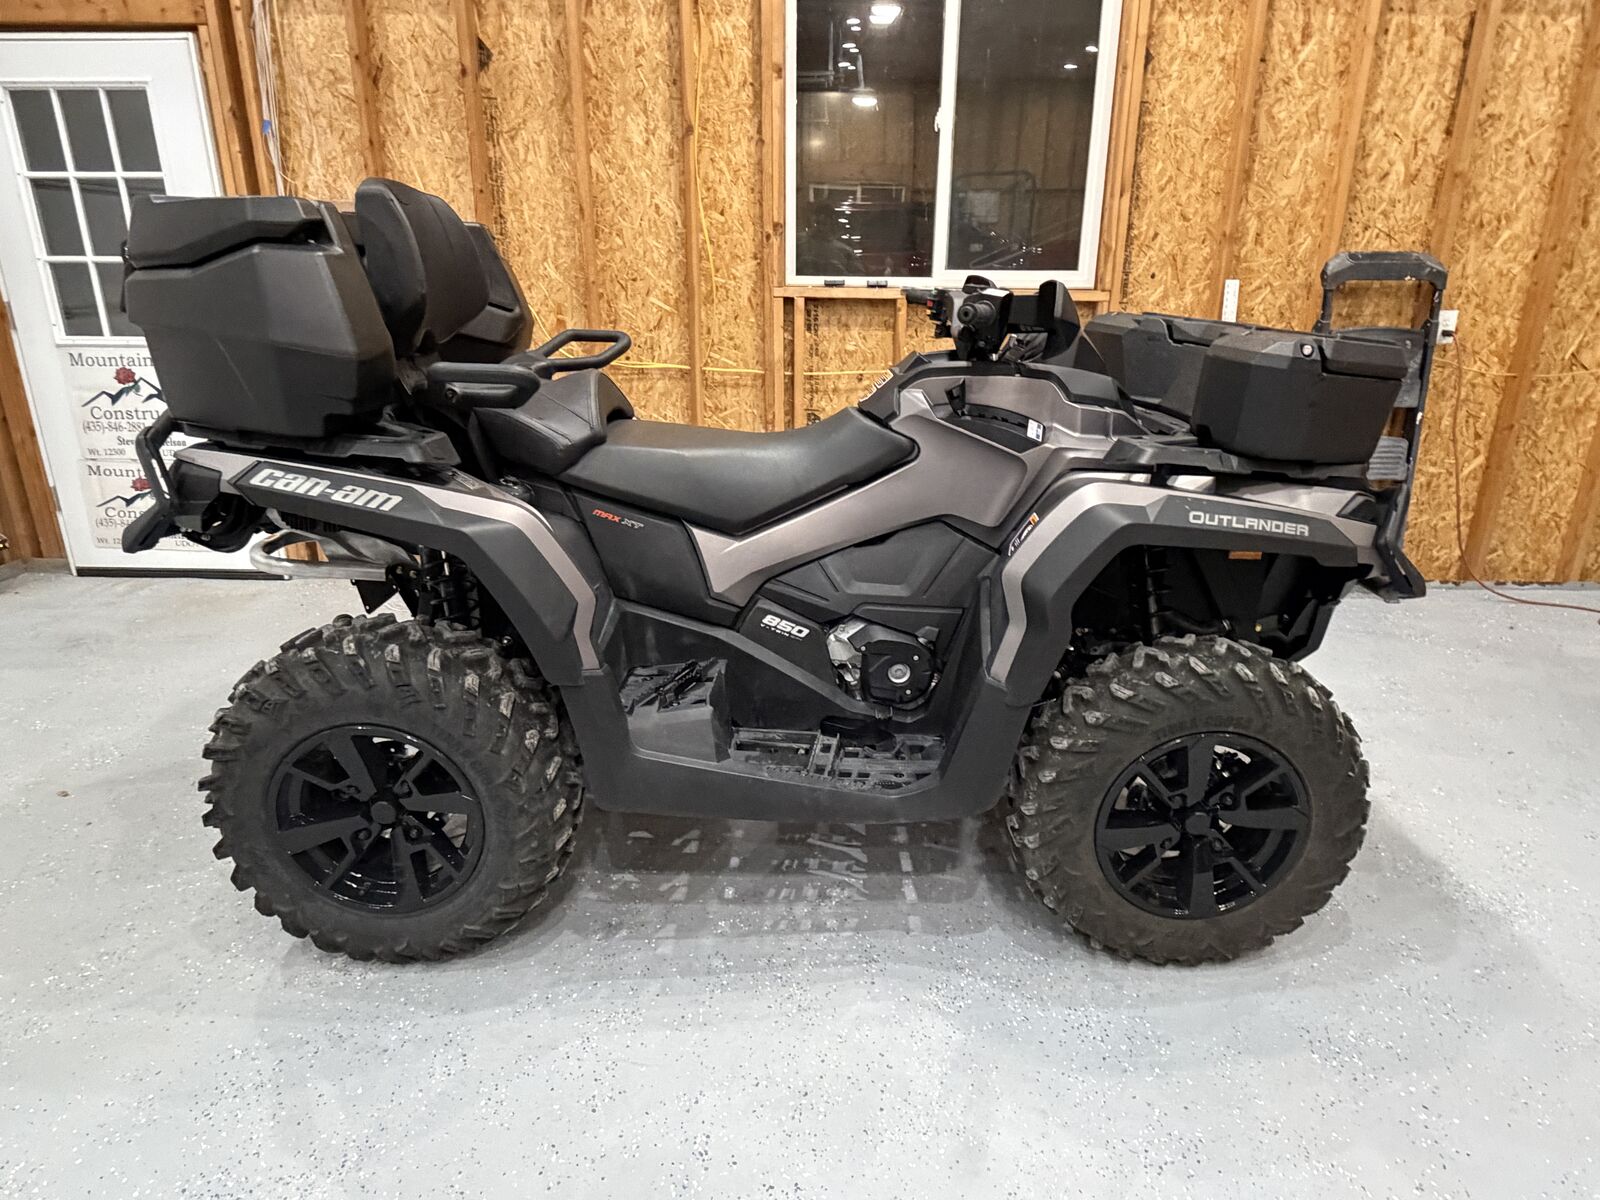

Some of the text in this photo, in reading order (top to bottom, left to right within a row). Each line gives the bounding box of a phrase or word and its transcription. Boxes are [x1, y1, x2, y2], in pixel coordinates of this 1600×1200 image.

[68, 352, 155, 367] Mountain
[90, 406, 159, 420] Constru
[88, 465, 143, 478] Mount
[105, 506, 145, 519] Cons
[1188, 510, 1309, 536] OUTLANDER
[761, 614, 810, 638] 850
